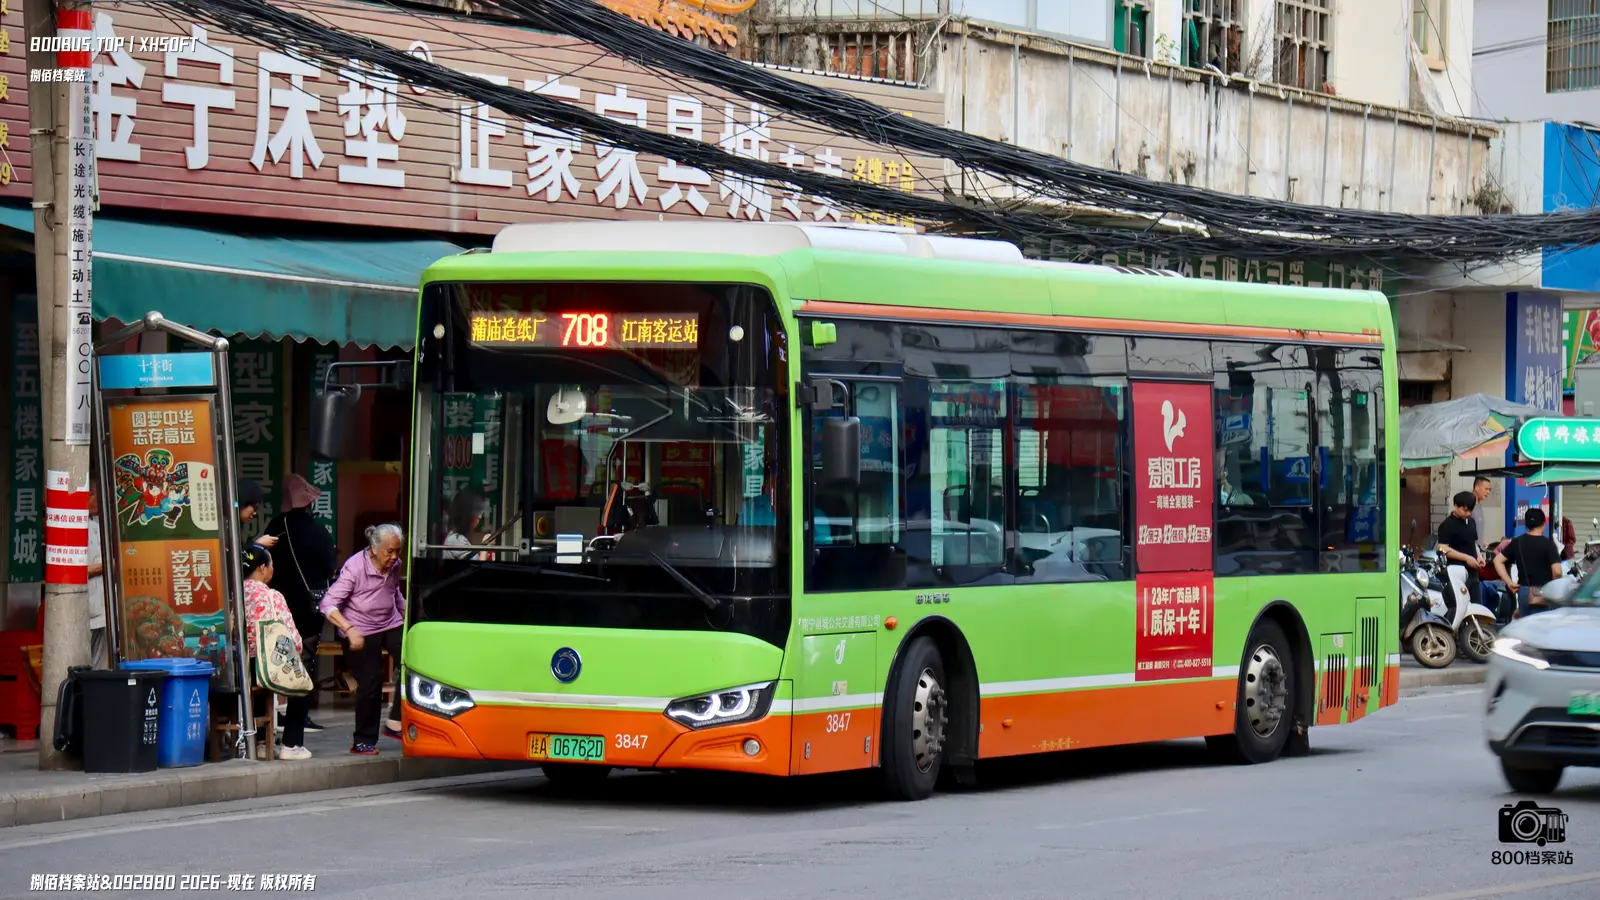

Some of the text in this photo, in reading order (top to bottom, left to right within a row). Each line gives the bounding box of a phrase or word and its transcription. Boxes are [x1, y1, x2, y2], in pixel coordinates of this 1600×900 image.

[73, 142, 86, 219] 长途光缆
[72, 228, 85, 303] 施工动土
[471, 313, 698, 347] 蒲庙造纸厂 708 江南客运站
[1525, 305, 1559, 354] 手机专业
[138, 359, 172, 373] 十字街
[132, 410, 194, 427] 圆梦中华
[14, 322, 39, 564] 至五楼家具城
[132, 428, 195, 445] 志存高远
[1148, 457, 1201, 489] 爱阁工房
[171, 550, 193, 605] 岁岁吉祥
[191, 550, 212, 591] 有德人
[1151, 587, 1200, 605] 23年广西品牌
[1150, 608, 1200, 636] 质保十年
[826, 713, 851, 733] 3847
[531, 736, 603, 758] 桂A 06762D
[615, 733, 648, 749] 3847
